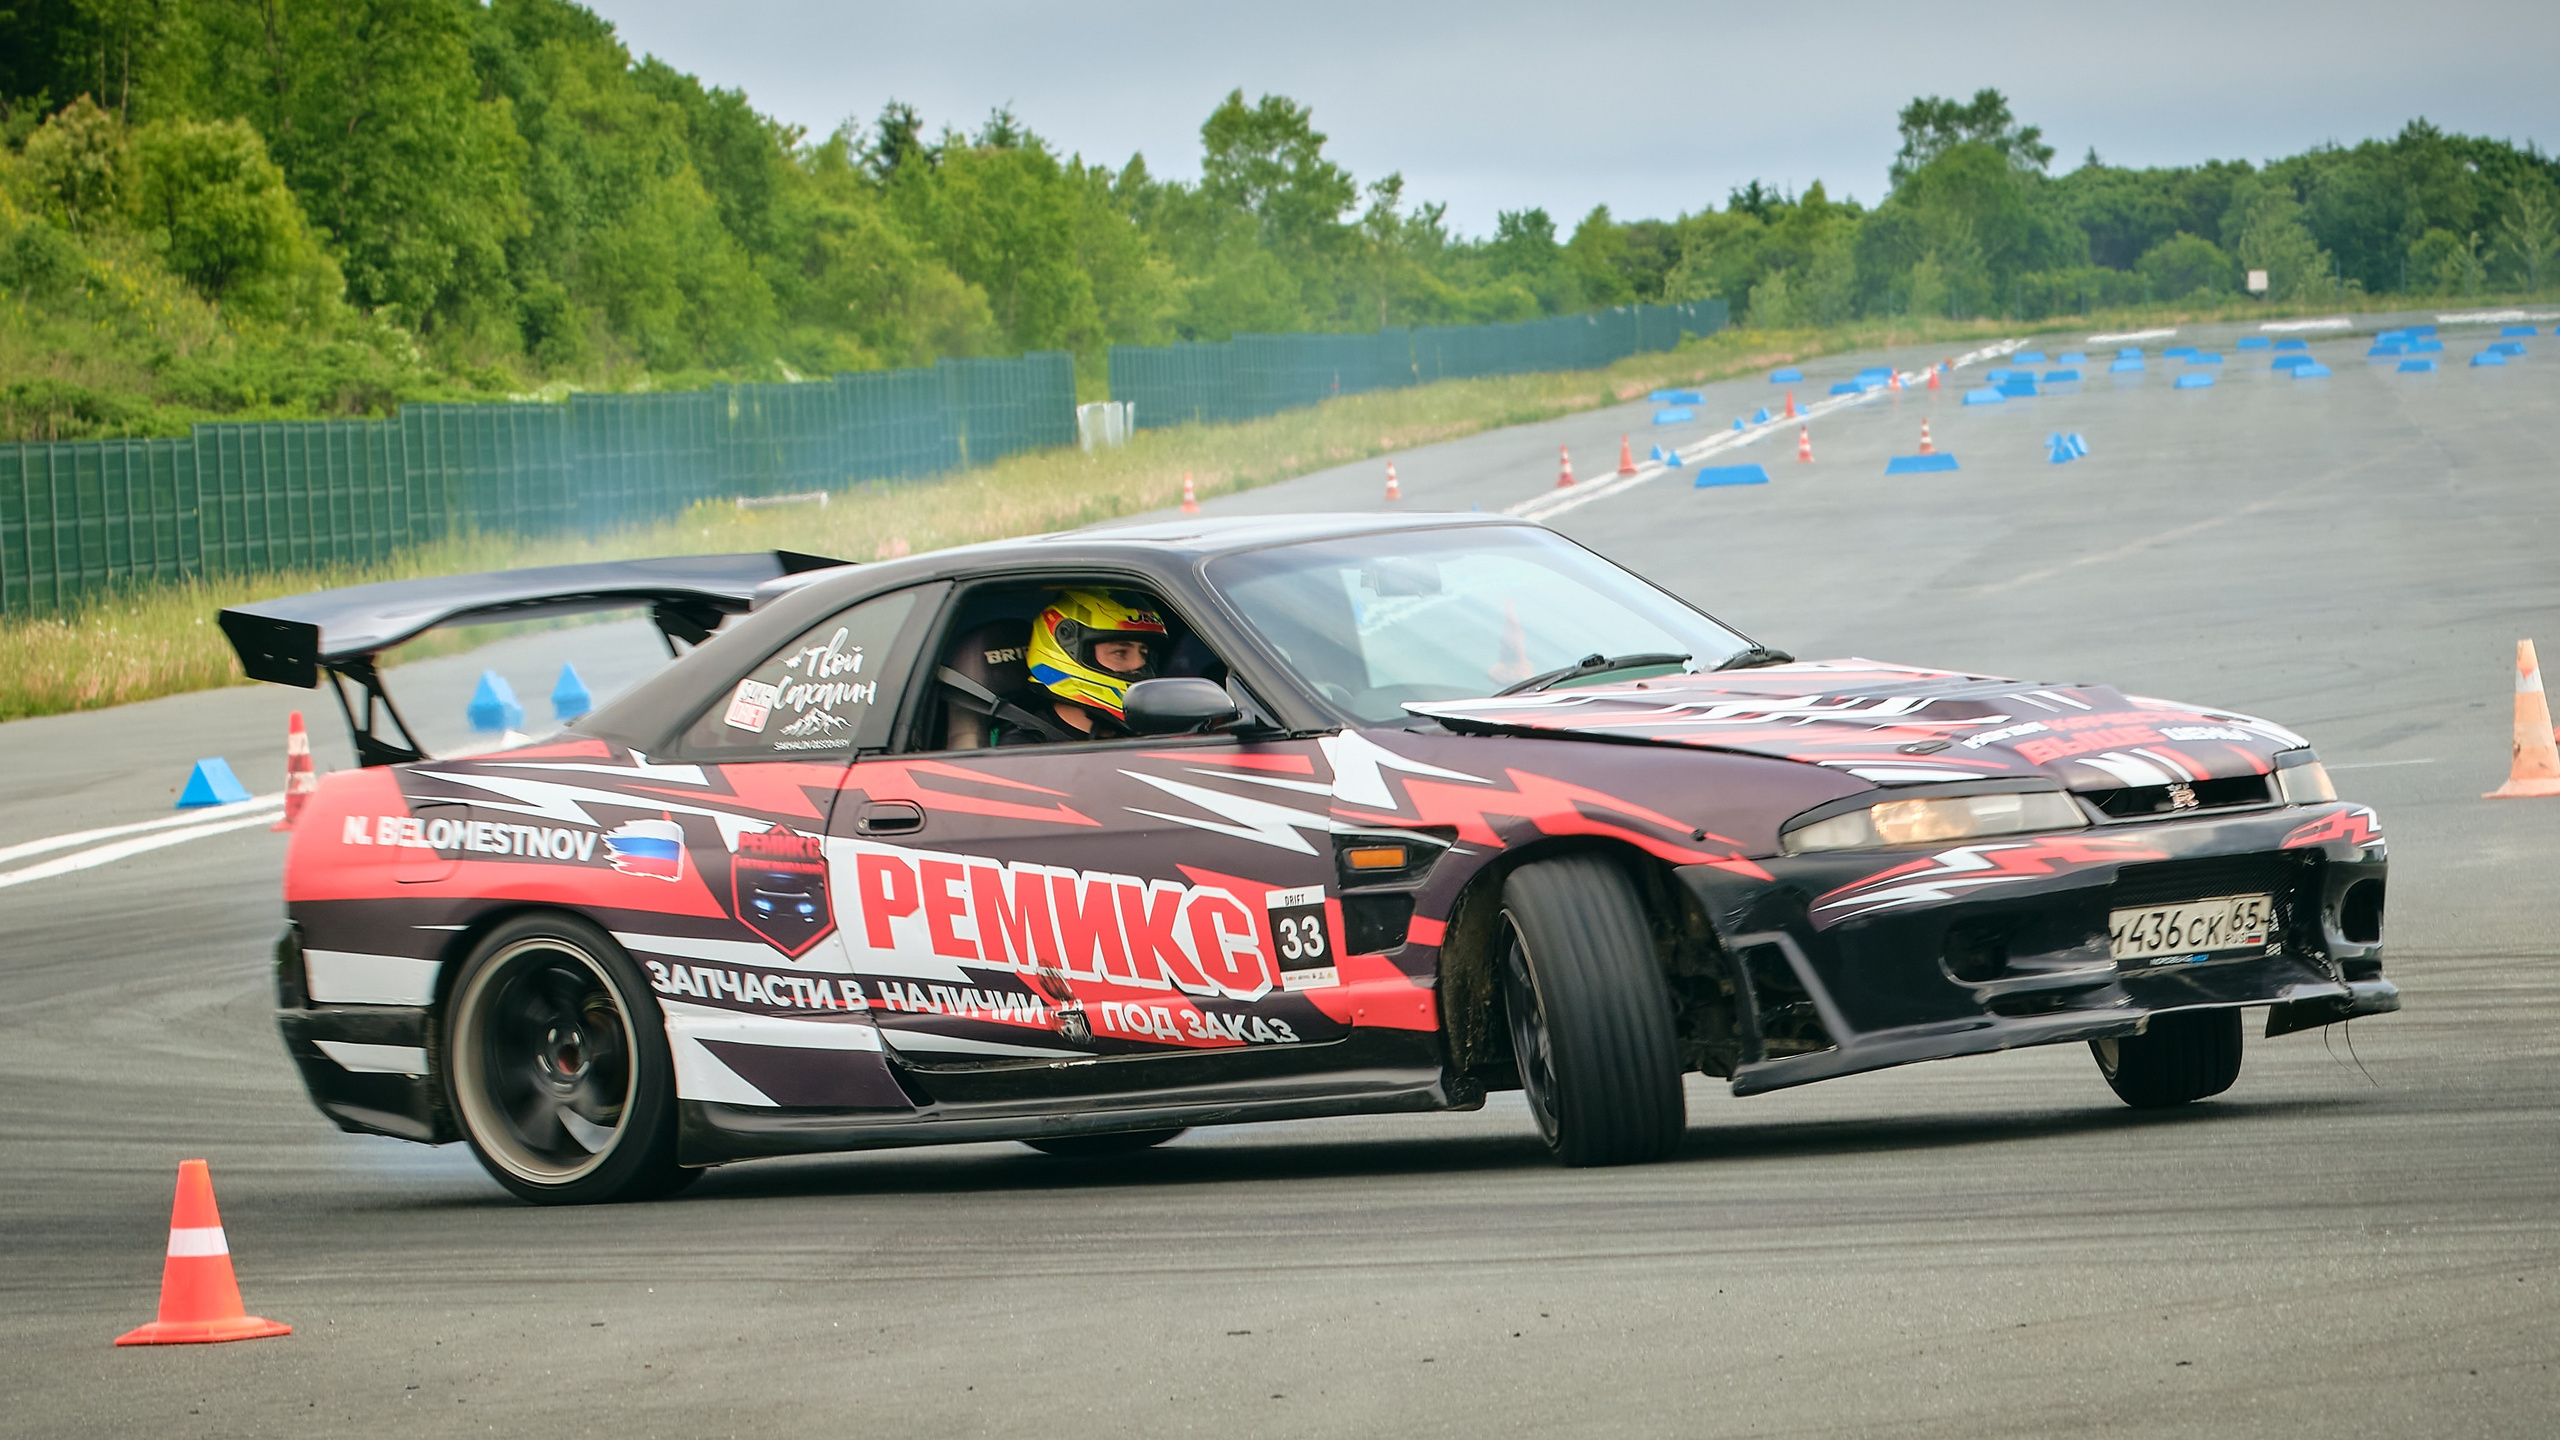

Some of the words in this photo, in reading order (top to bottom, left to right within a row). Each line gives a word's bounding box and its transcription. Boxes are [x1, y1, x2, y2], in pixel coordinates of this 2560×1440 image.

[801, 627, 864, 679] Твой
[984, 647, 1029, 664] BRI
[2013, 725, 2168, 766] ВЫШЕ
[376, 816, 599, 861] BELOMESTNOV
[738, 831, 821, 859] РЕМИКС
[1284, 893, 1305, 906] DRIFT
[2232, 901, 2261, 931] 65
[856, 852, 1270, 999] РЕМИКС
[1280, 915, 1325, 960] 33
[645, 960, 838, 1011] ЗАПЧАСТИ
[838, 979, 870, 1011] В
[876, 980, 1046, 1025] НАЛИЧИИ
[1102, 1001, 1185, 1041] ПОД
[1179, 1009, 1300, 1043] ЗАКАЗ
